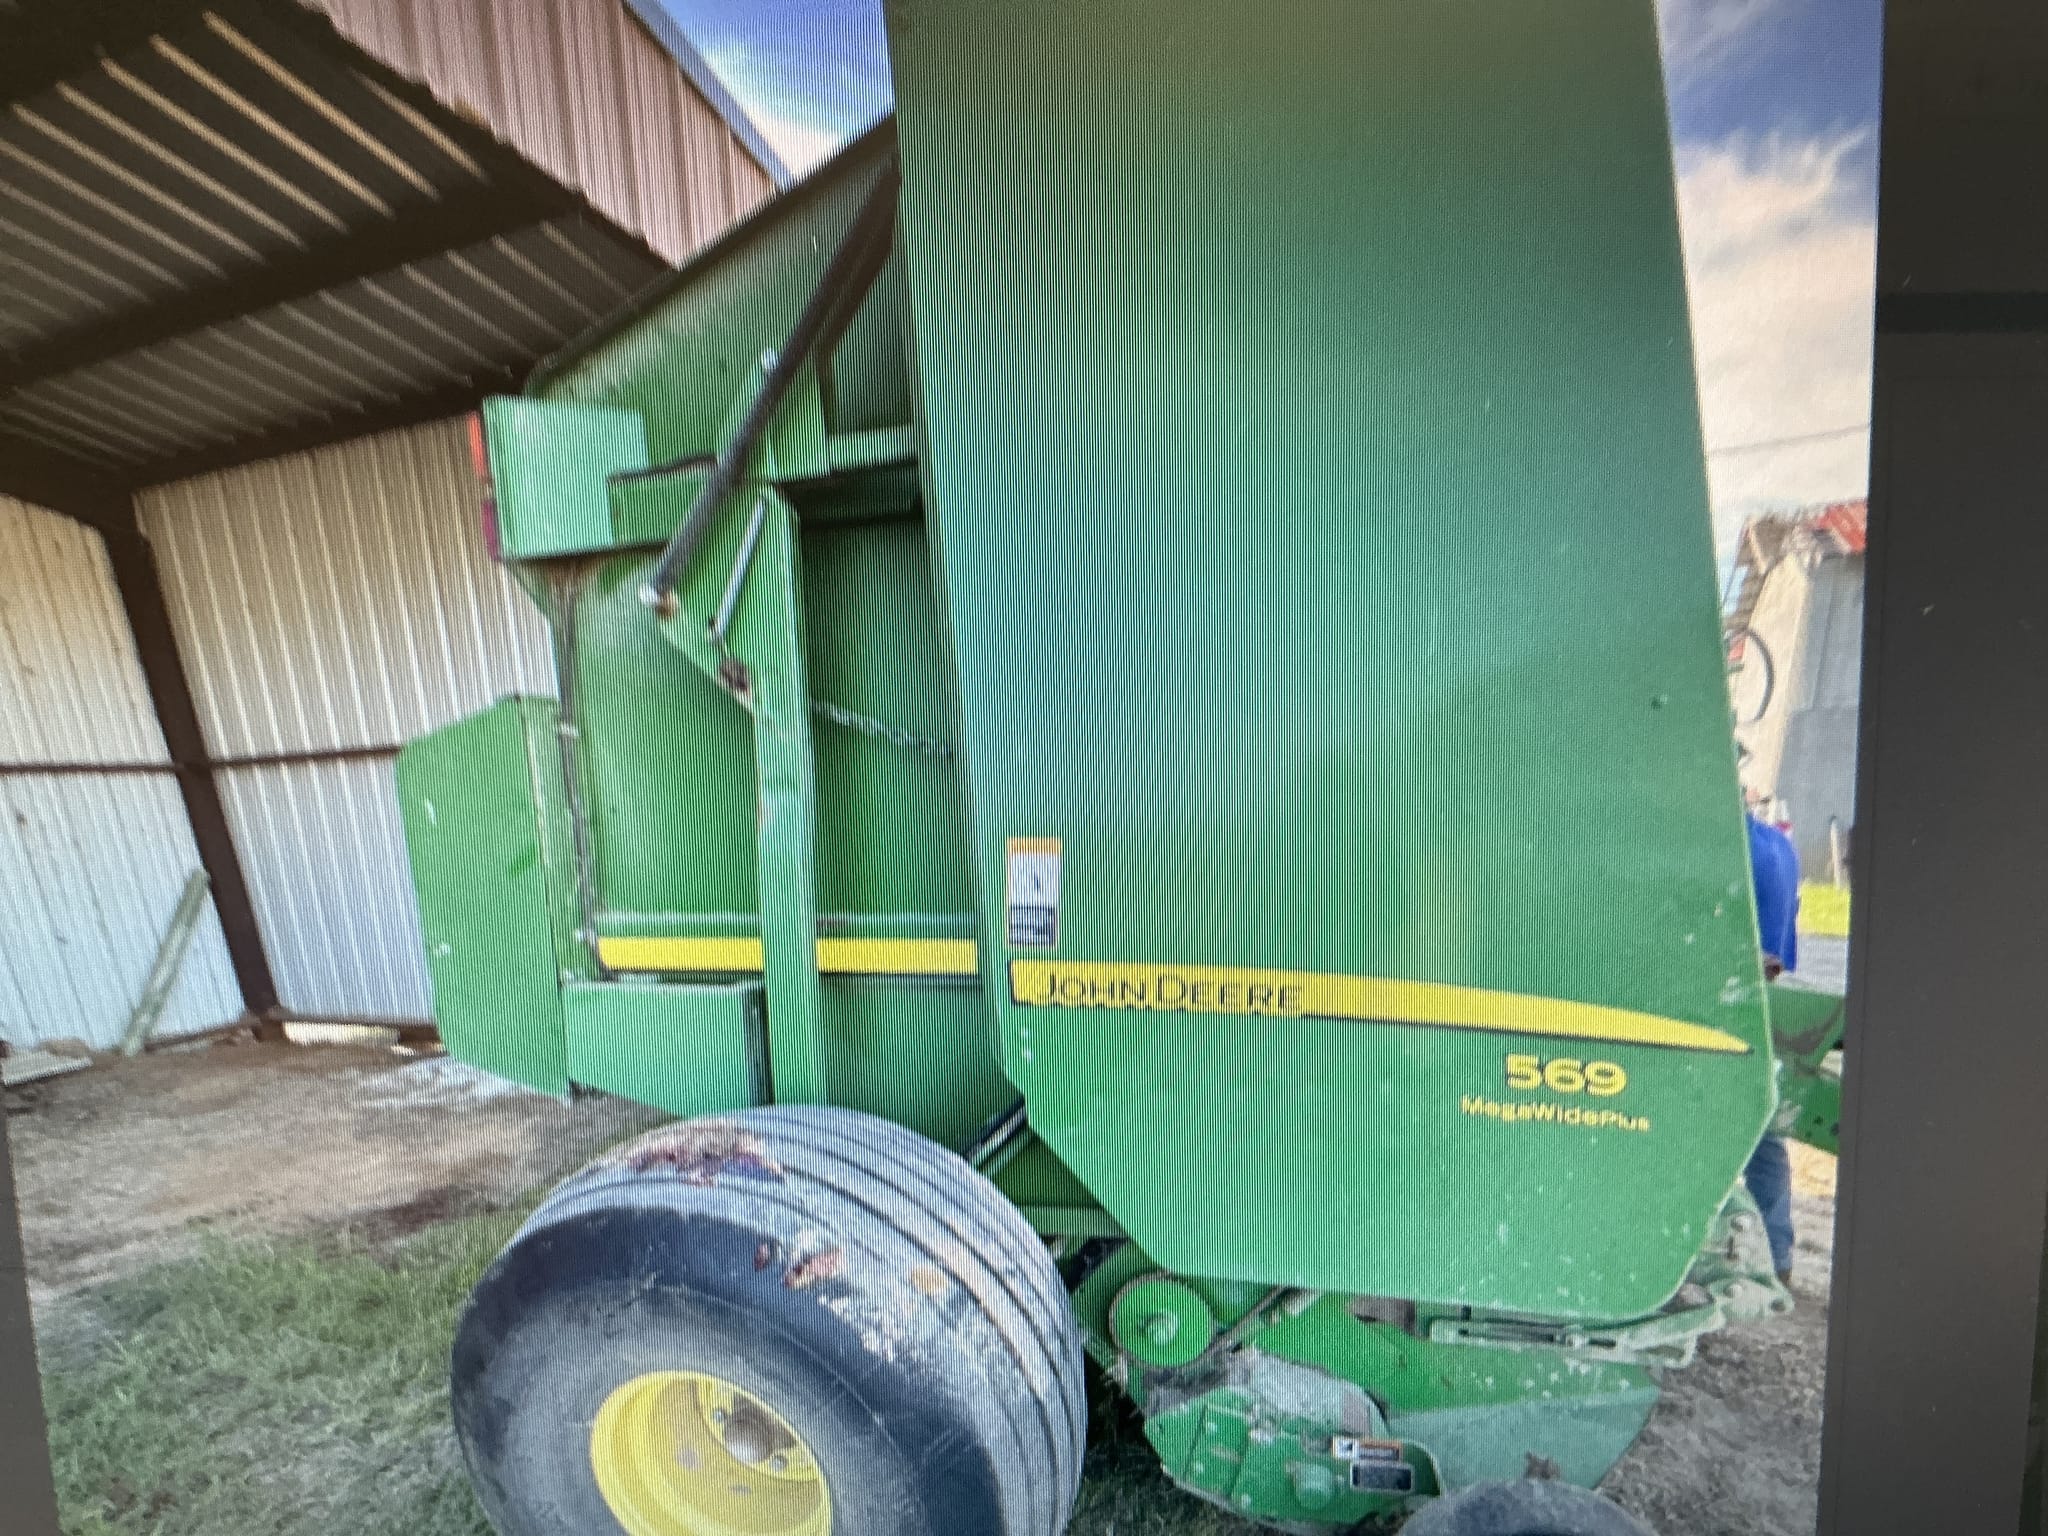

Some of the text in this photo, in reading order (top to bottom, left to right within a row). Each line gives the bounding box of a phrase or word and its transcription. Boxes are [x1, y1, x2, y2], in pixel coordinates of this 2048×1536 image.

[1039, 973, 1303, 1011] JOHN DEERE
[1506, 1053, 1627, 1096] 569
